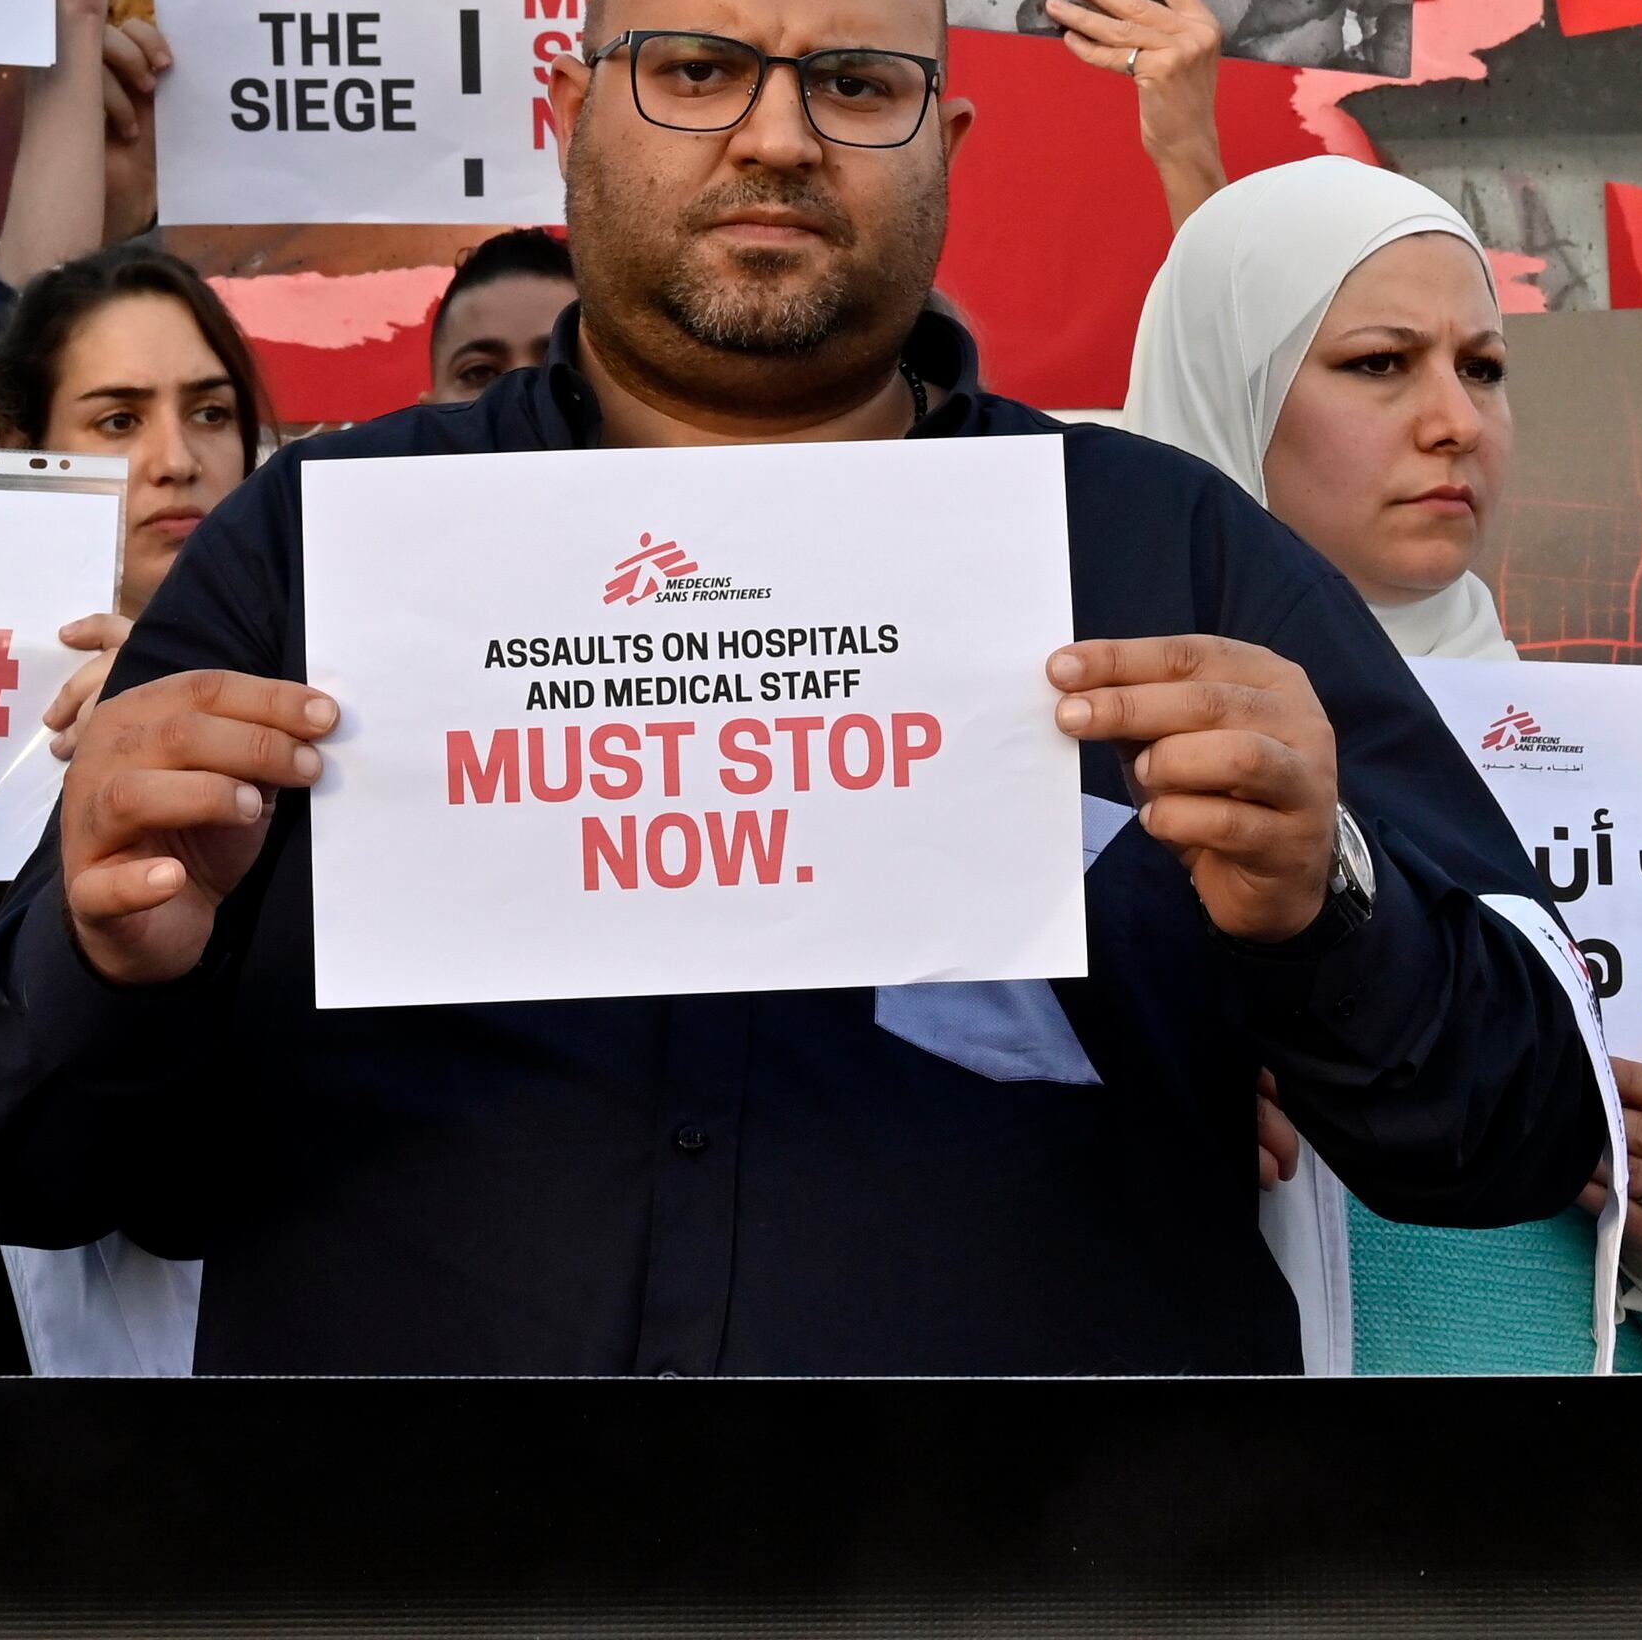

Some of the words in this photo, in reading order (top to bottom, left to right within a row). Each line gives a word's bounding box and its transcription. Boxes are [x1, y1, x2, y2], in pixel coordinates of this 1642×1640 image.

[259, 12, 382, 67] THE
[229, 78, 417, 133] SIEGE
[655, 591, 688, 603] SANS
[691, 587, 773, 602] FRONTIERES
[665, 576, 732, 590] MEDECINS
[484, 631, 654, 669] ASSAULTS
[661, 630, 707, 665] ON
[717, 623, 900, 661] HOSPITALS
[526, 676, 596, 711] AND
[603, 672, 754, 708] MEDICAL
[758, 668, 862, 703] STAFF
[446, 720, 695, 806] MUST
[717, 712, 943, 796] STOP
[580, 808, 815, 893] NOW.
